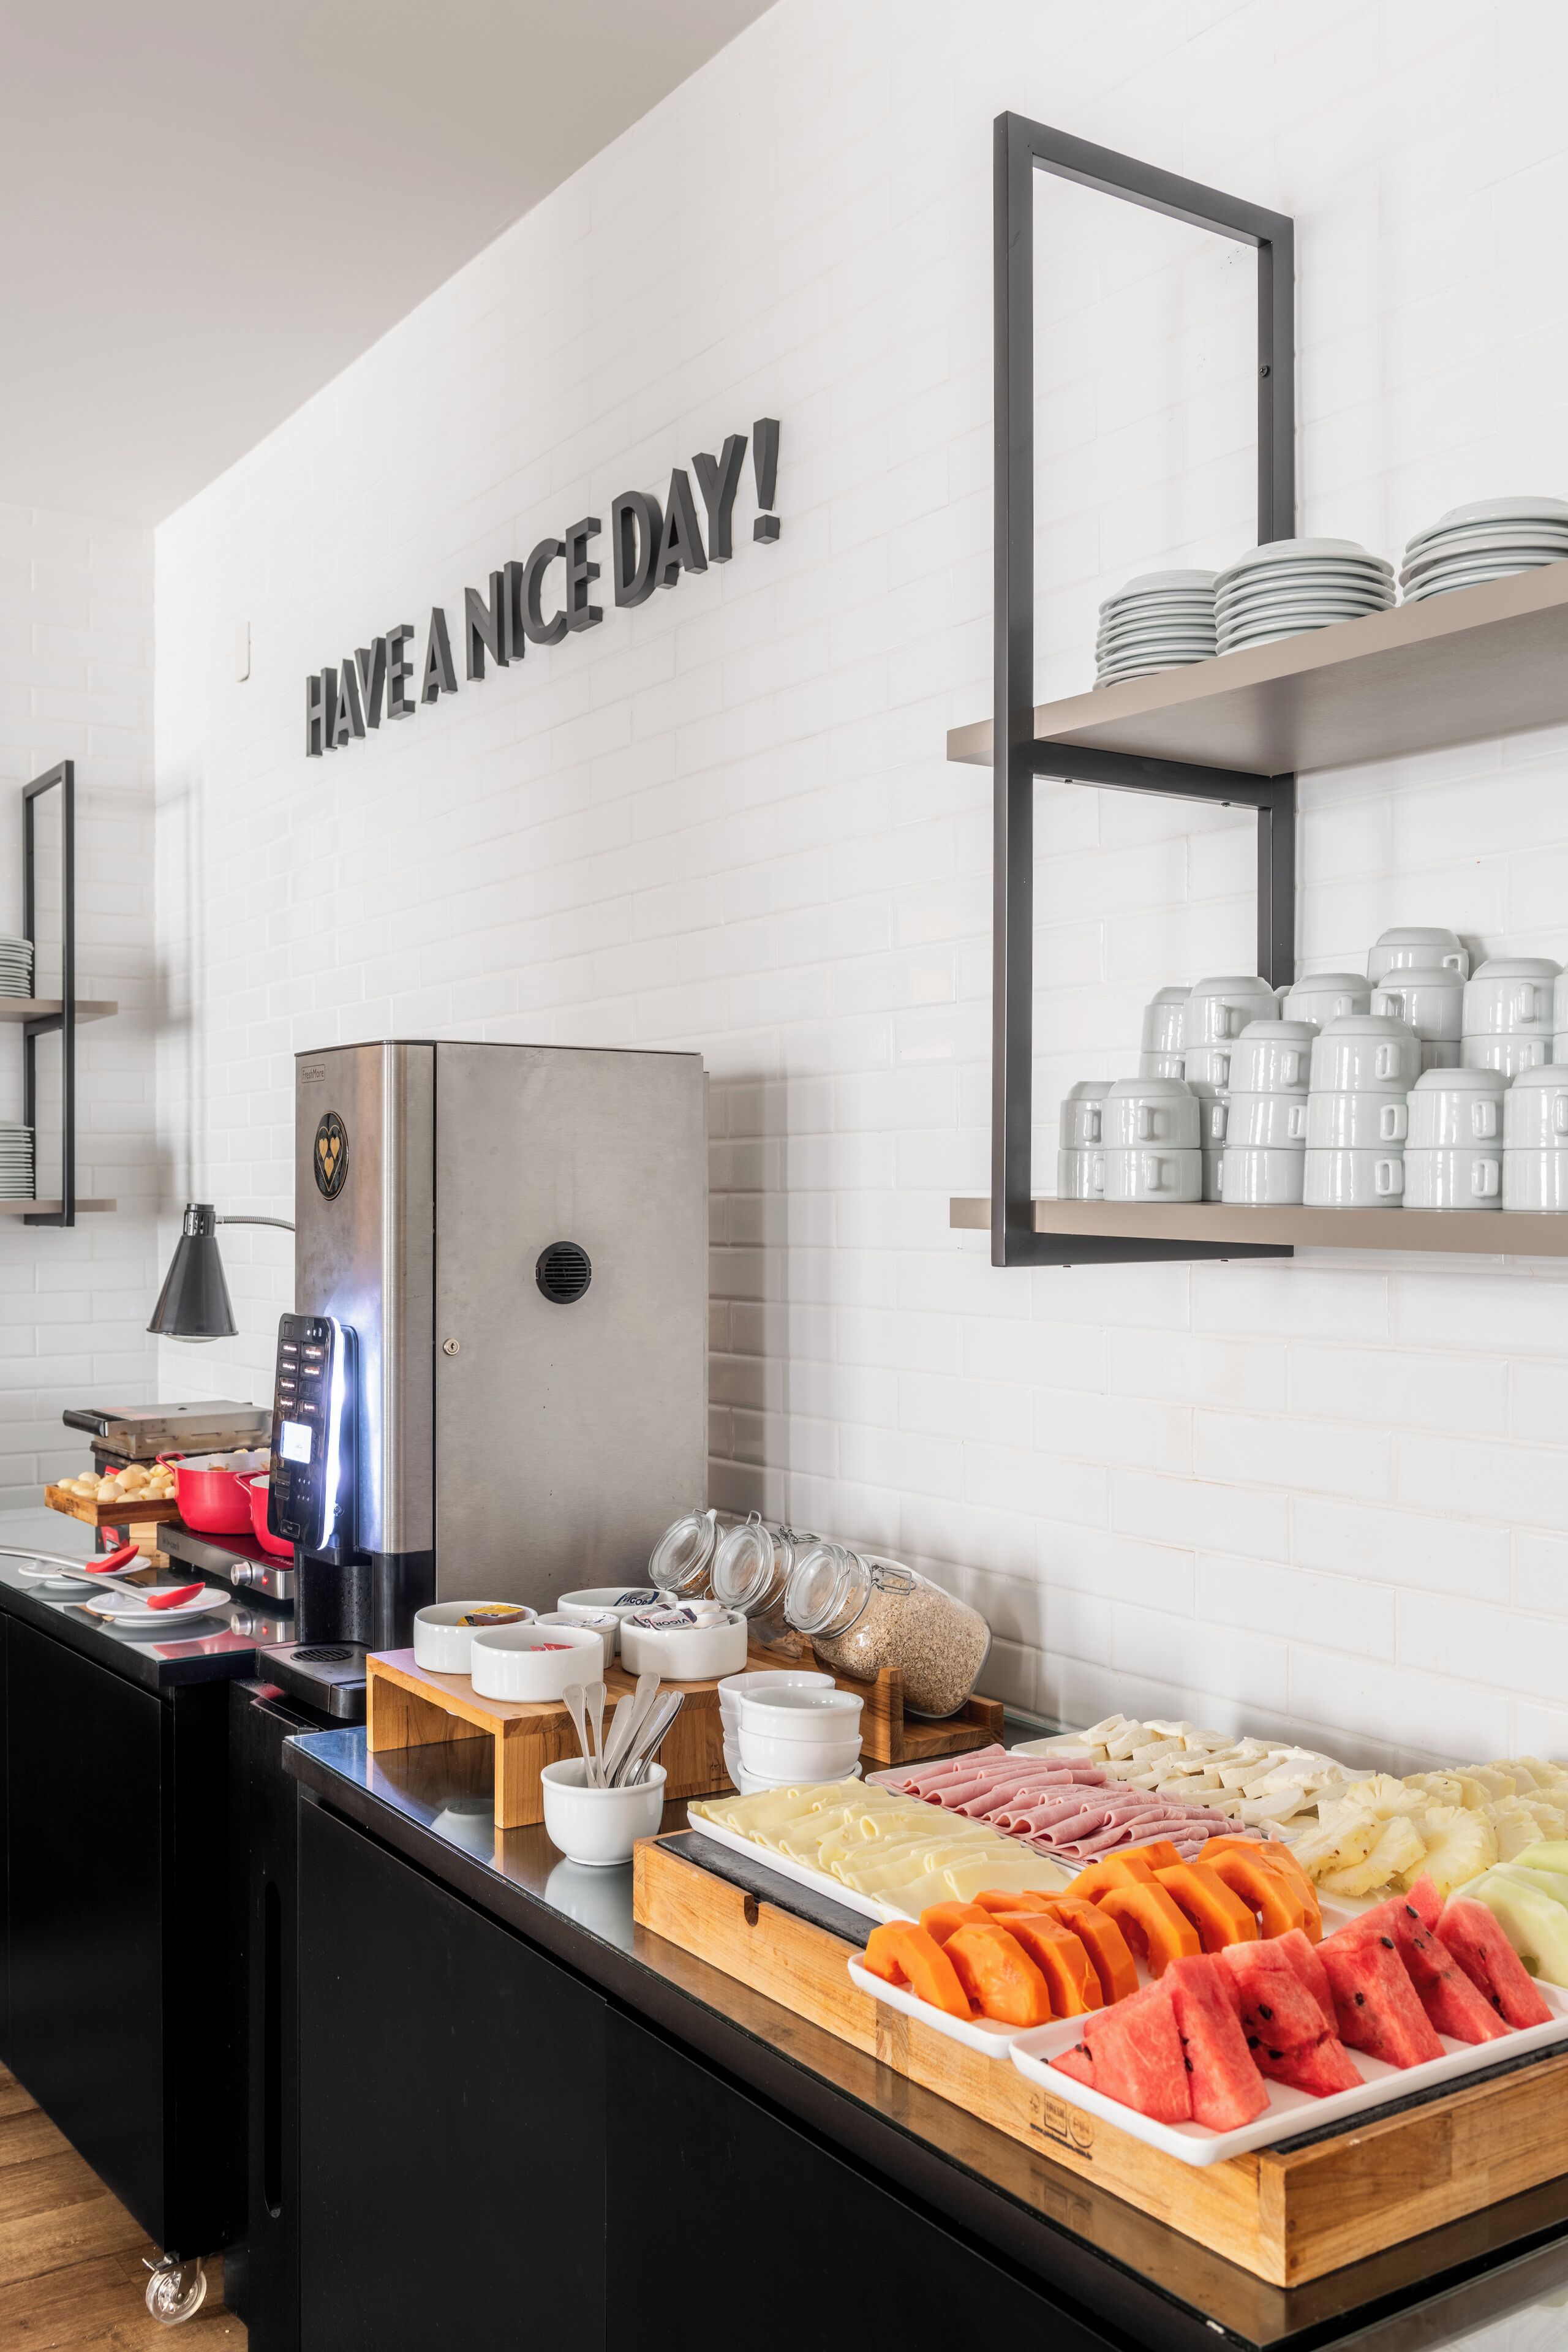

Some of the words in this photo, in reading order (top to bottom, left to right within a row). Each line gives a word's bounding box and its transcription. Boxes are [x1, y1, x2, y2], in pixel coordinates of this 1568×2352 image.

[306, 624, 416, 758] HAVE
[421, 606, 458, 704] A
[464, 516, 603, 681] NICE
[611, 417, 781, 608] DAY!
[623, 1595, 647, 1606] VIGOR
[654, 1618, 690, 1627] VIGOR
